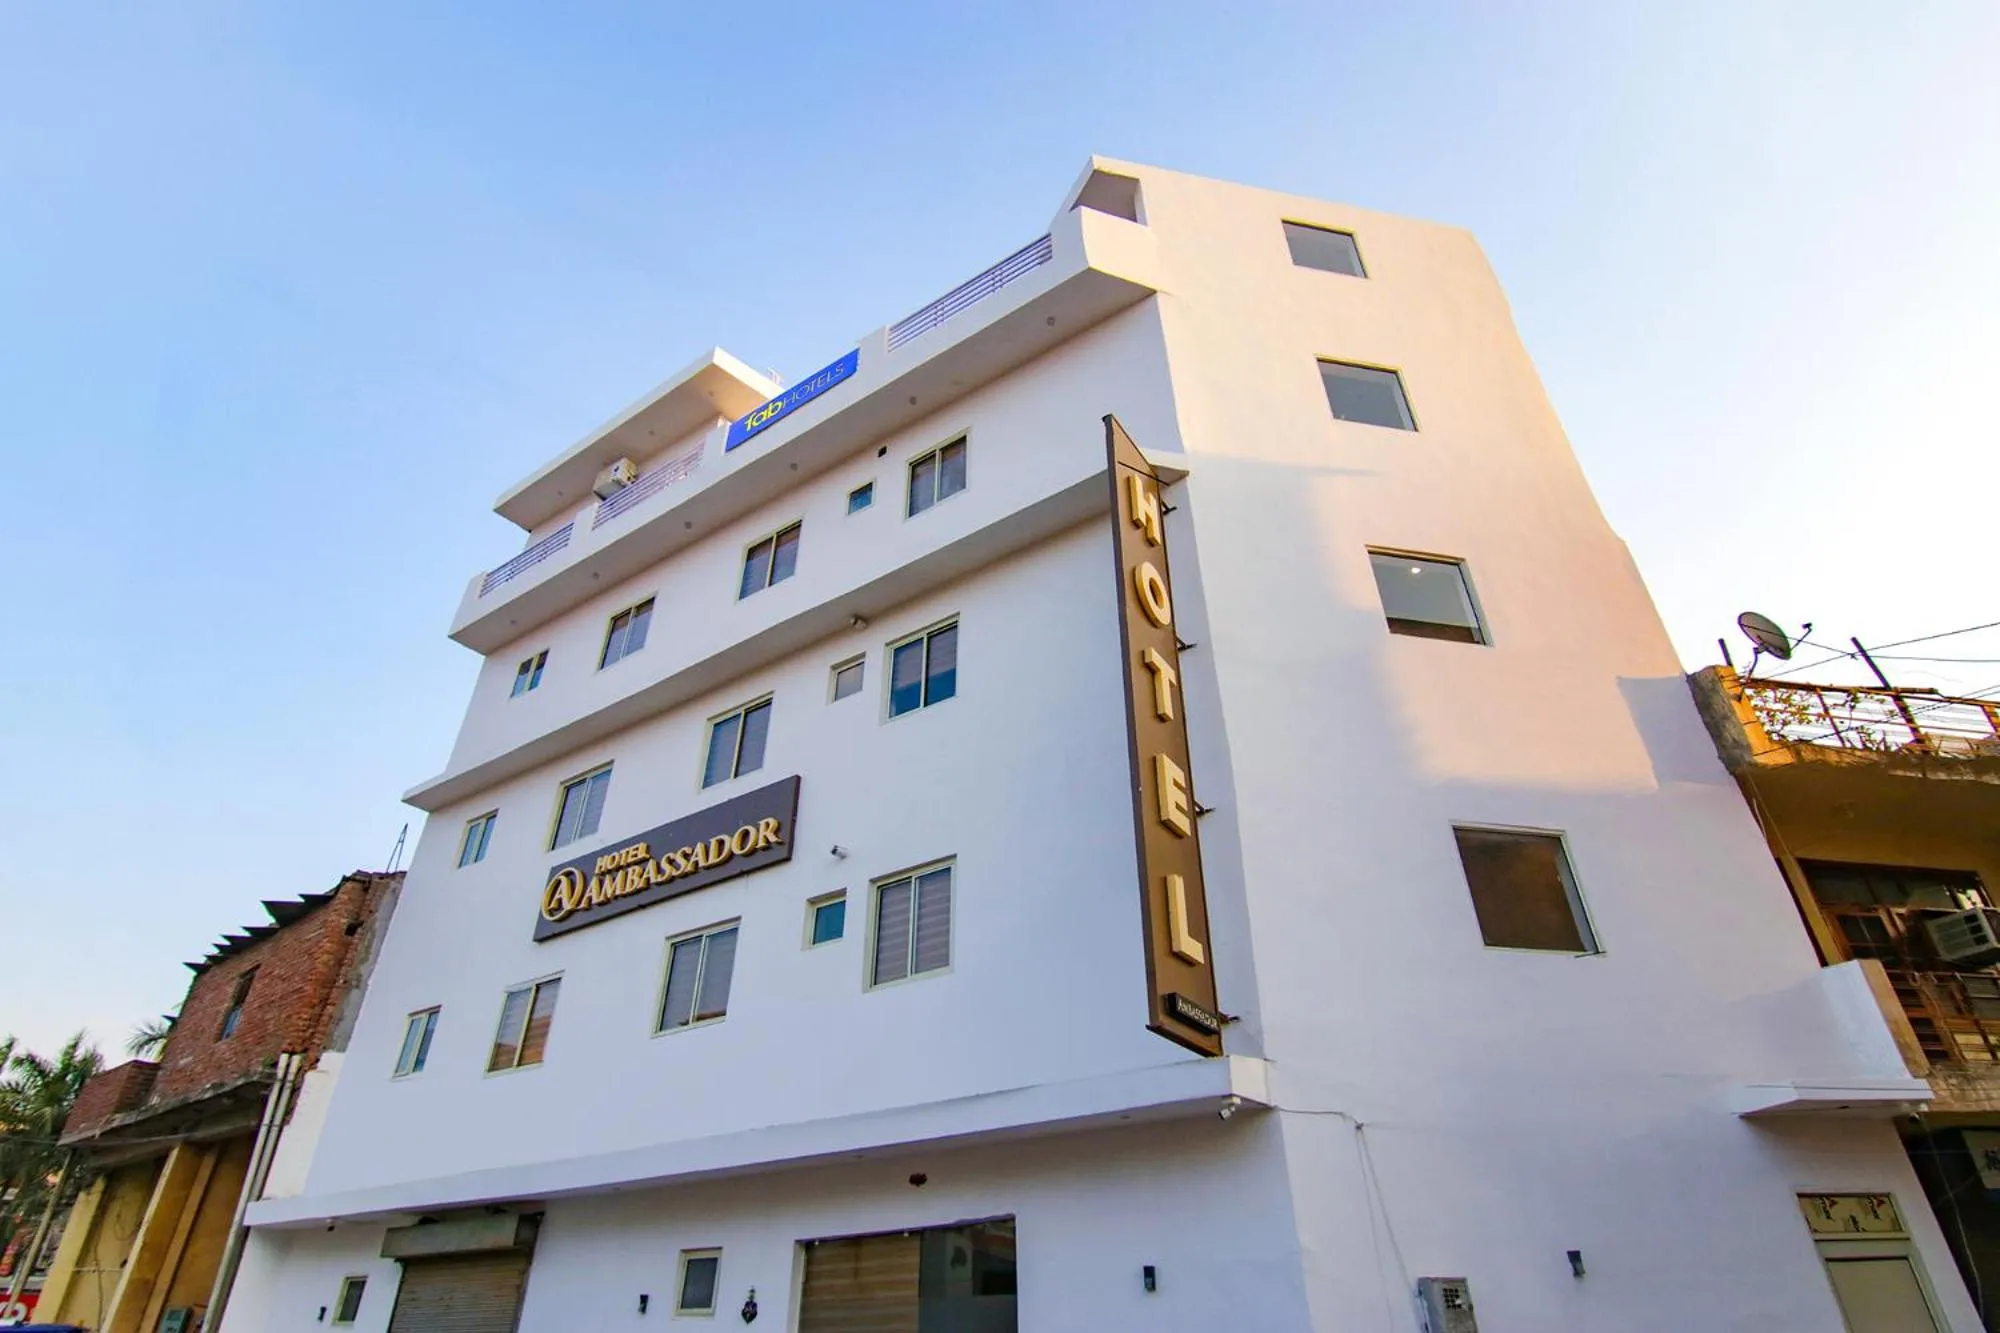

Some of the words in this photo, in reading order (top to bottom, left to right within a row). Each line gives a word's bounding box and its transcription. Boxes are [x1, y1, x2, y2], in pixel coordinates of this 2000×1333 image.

[1128, 474, 1205, 967] HOTEL
[576, 817, 785, 911] AMBASSADOR
[595, 842, 650, 876] HOTEL
